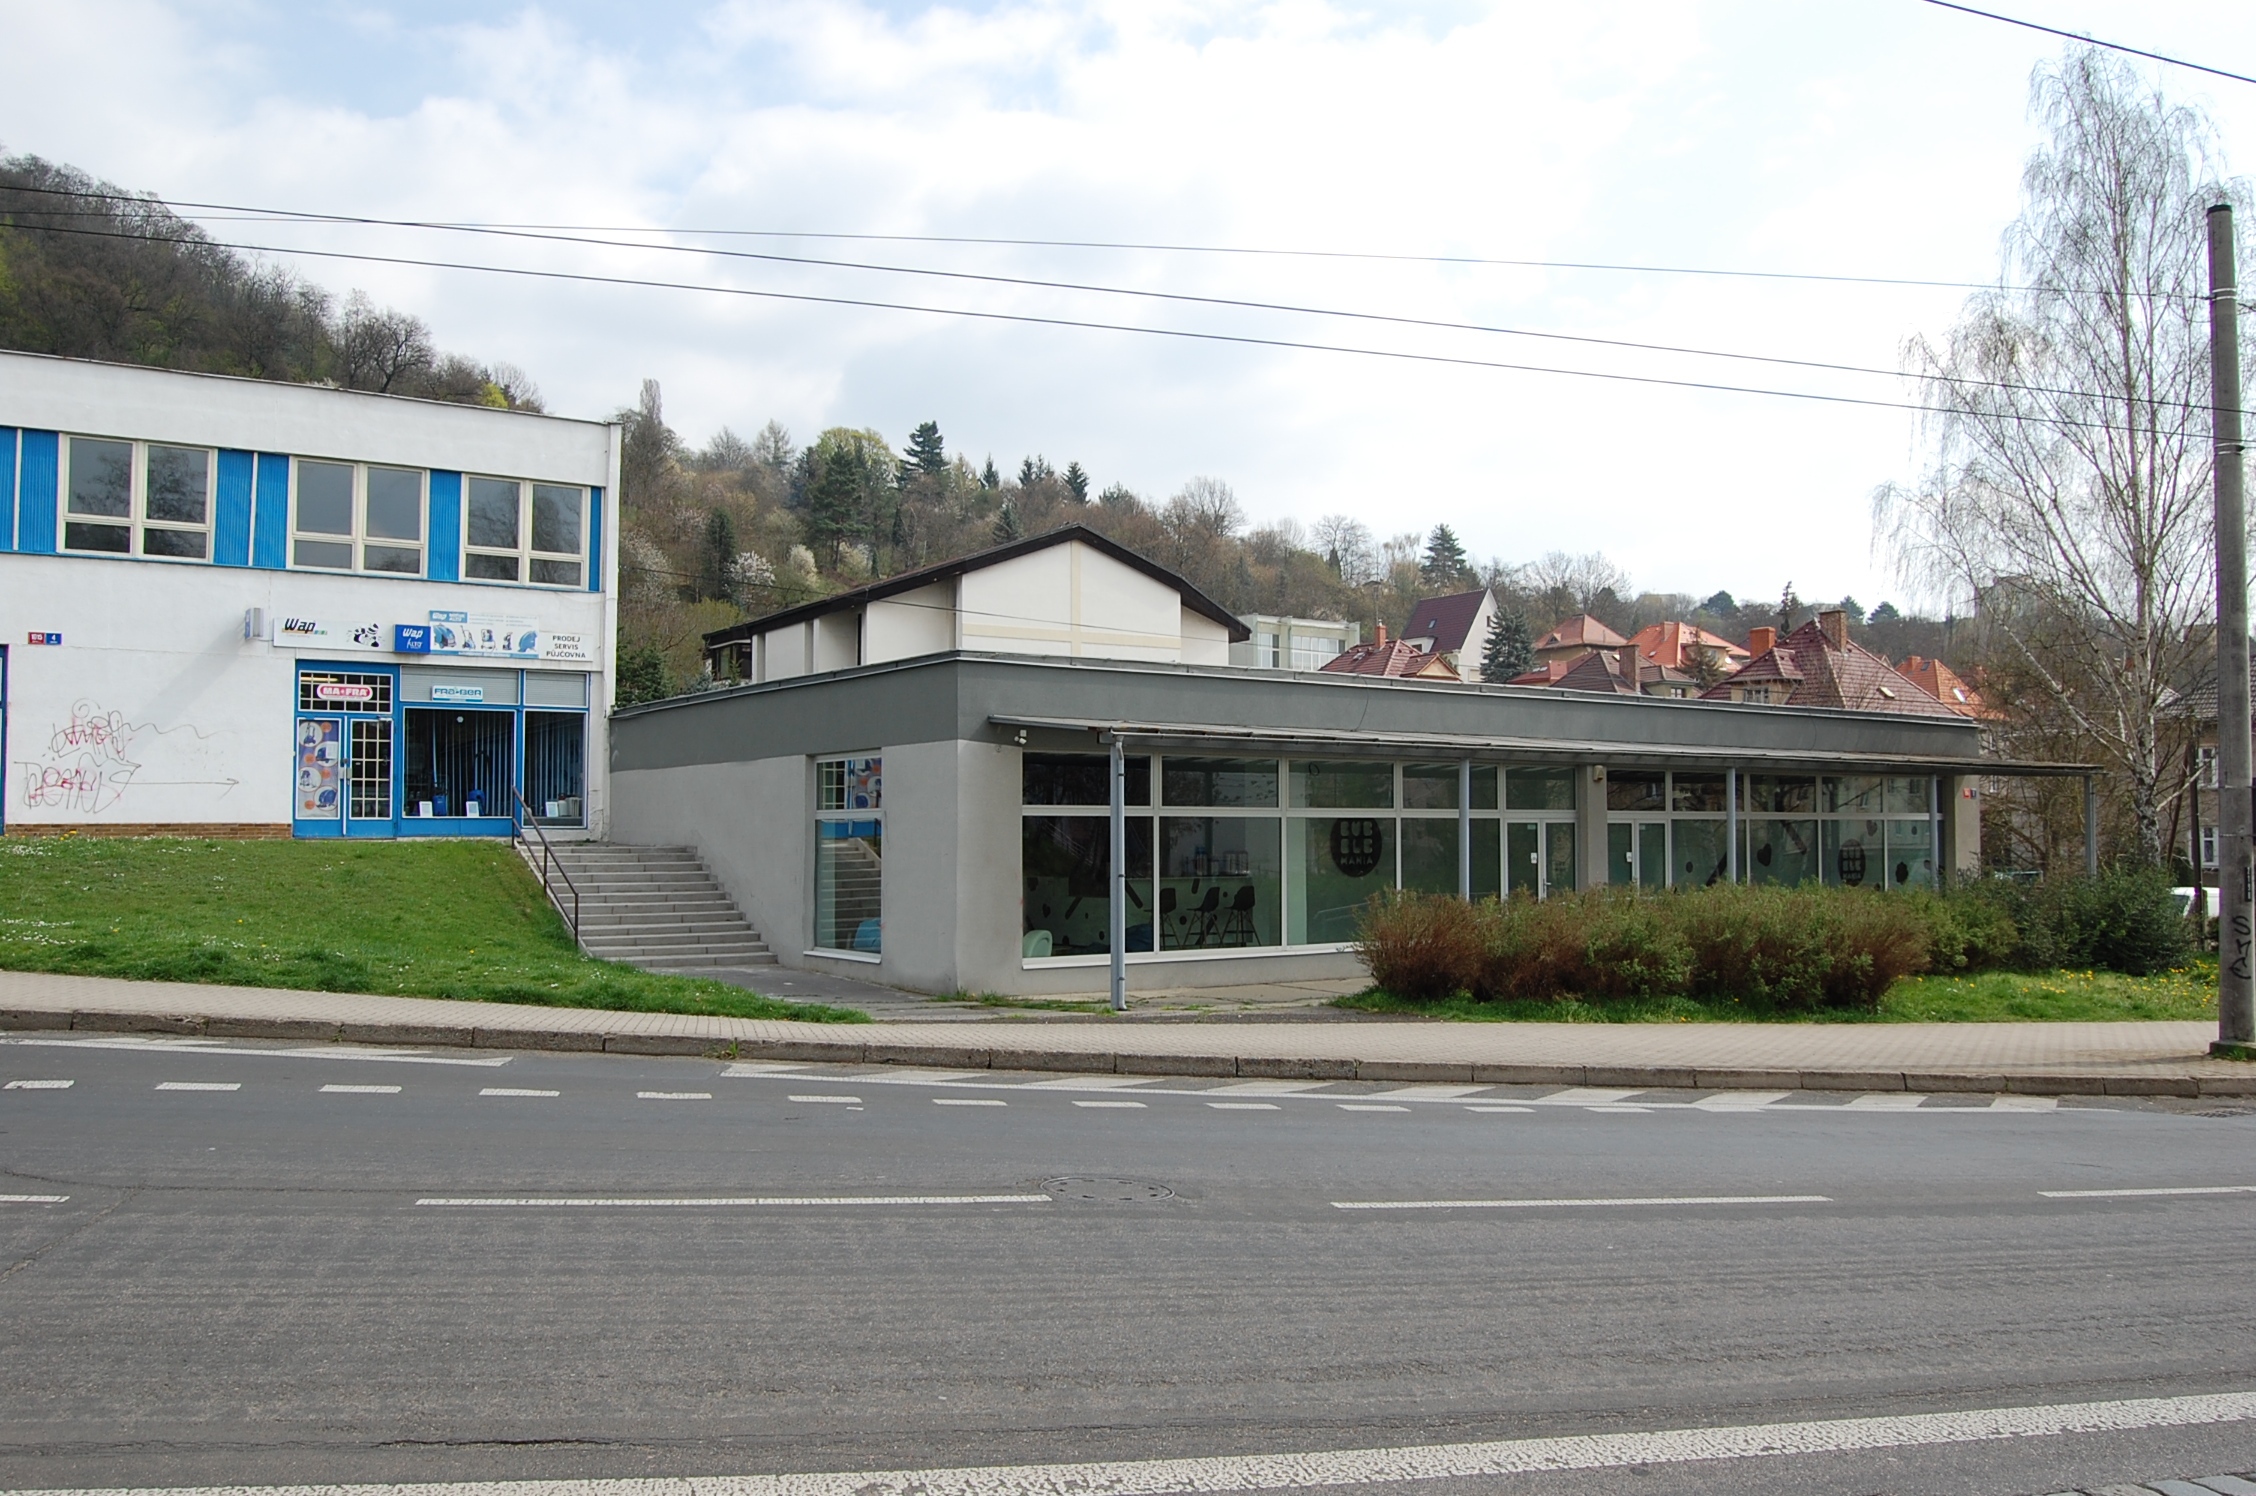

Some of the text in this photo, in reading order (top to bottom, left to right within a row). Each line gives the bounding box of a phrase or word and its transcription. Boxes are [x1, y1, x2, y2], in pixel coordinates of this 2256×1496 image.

[284, 618, 316, 634] Wap
[402, 627, 424, 639] Wap
[552, 635, 581, 643] PRODEJ
[1340, 855, 1373, 865] MANIA
